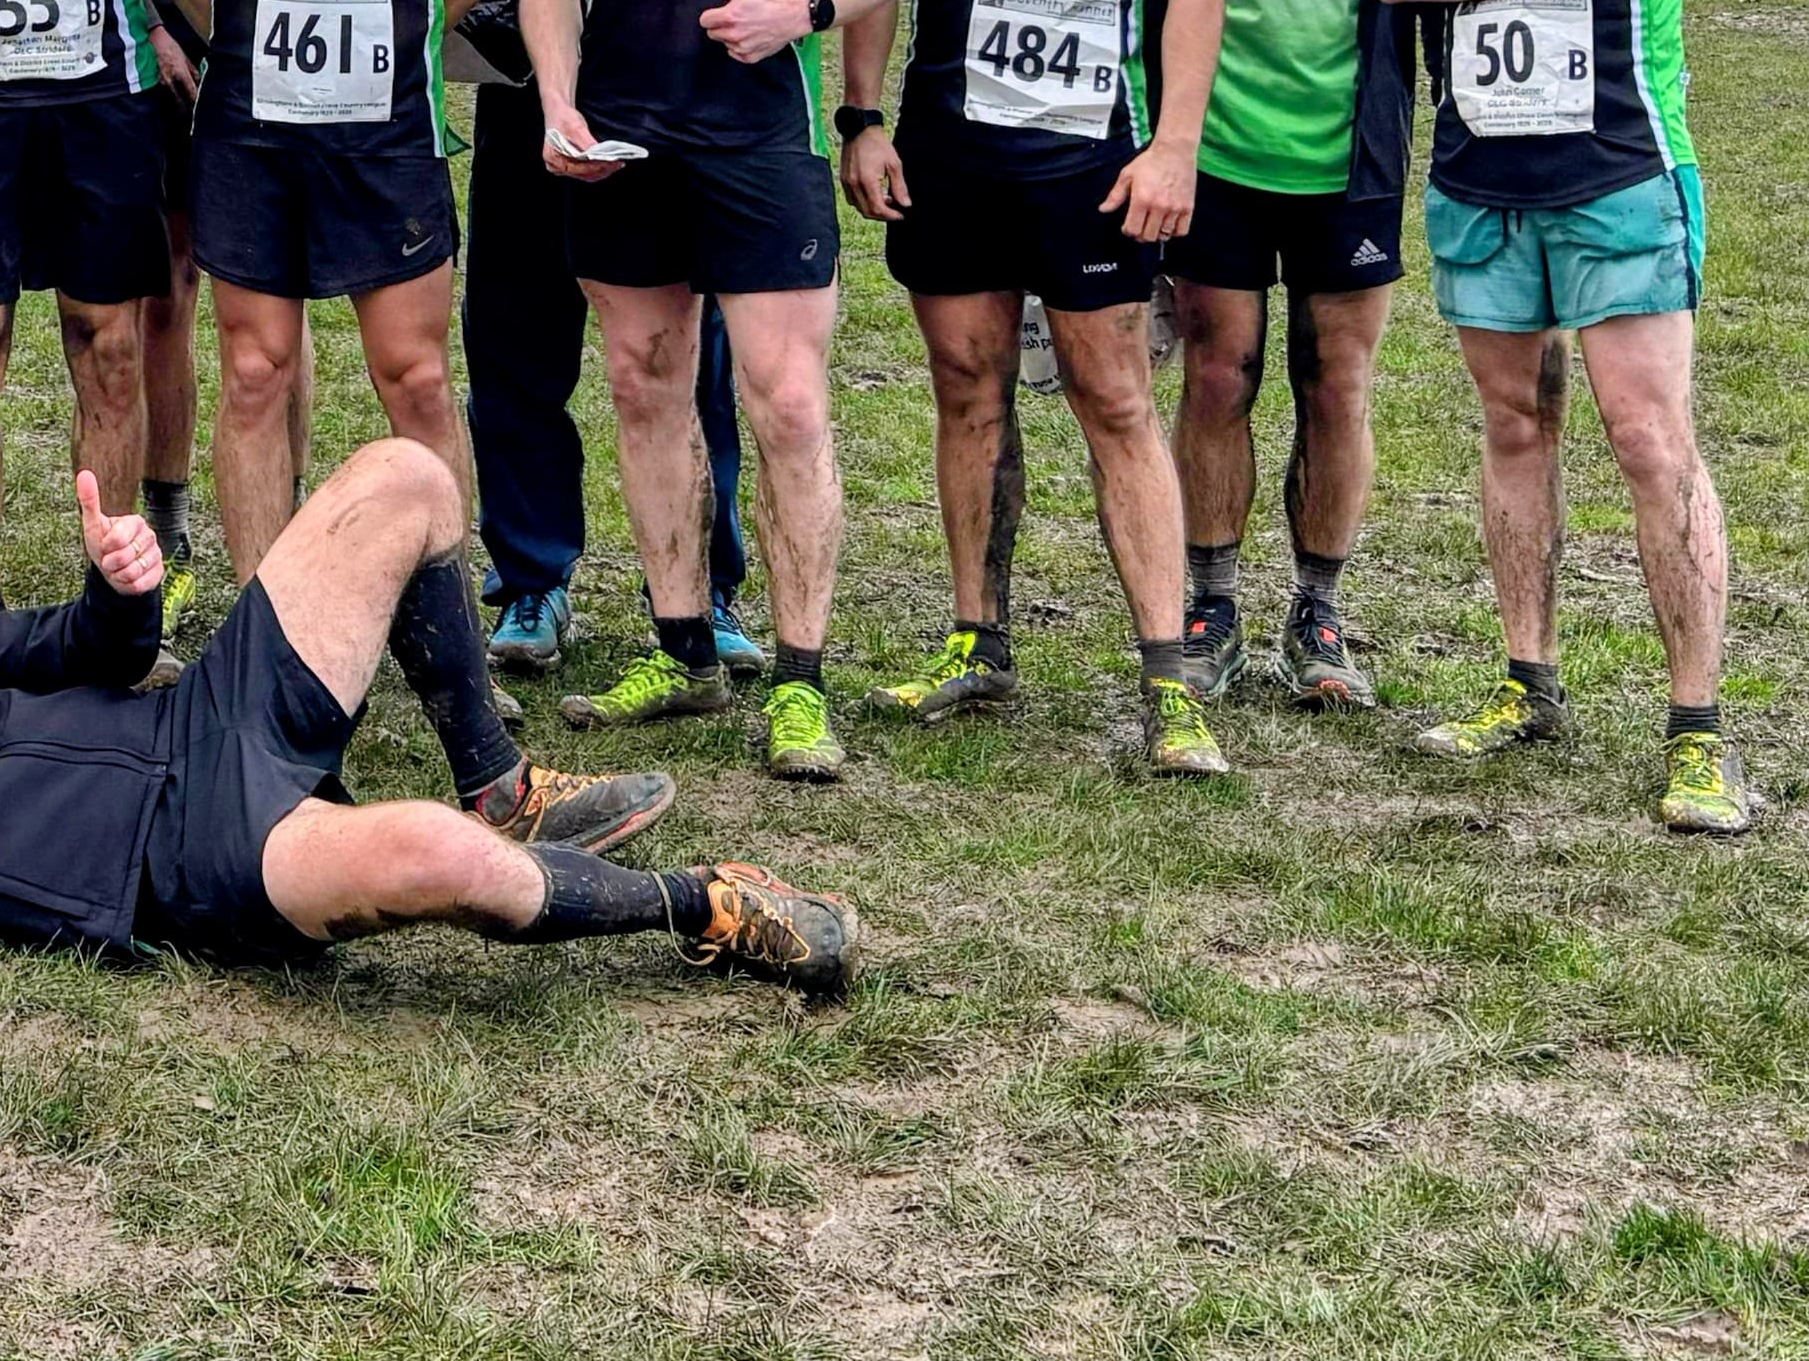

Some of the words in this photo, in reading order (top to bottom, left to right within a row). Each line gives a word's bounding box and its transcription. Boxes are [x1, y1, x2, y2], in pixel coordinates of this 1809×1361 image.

[263, 12, 352, 73] 461
[372, 44, 389, 73] B
[978, 20, 1081, 88] 484
[1094, 65, 1113, 93] B
[1476, 20, 1535, 86] 50
[1568, 49, 1588, 80] B
[1351, 252, 1388, 267] adidas
